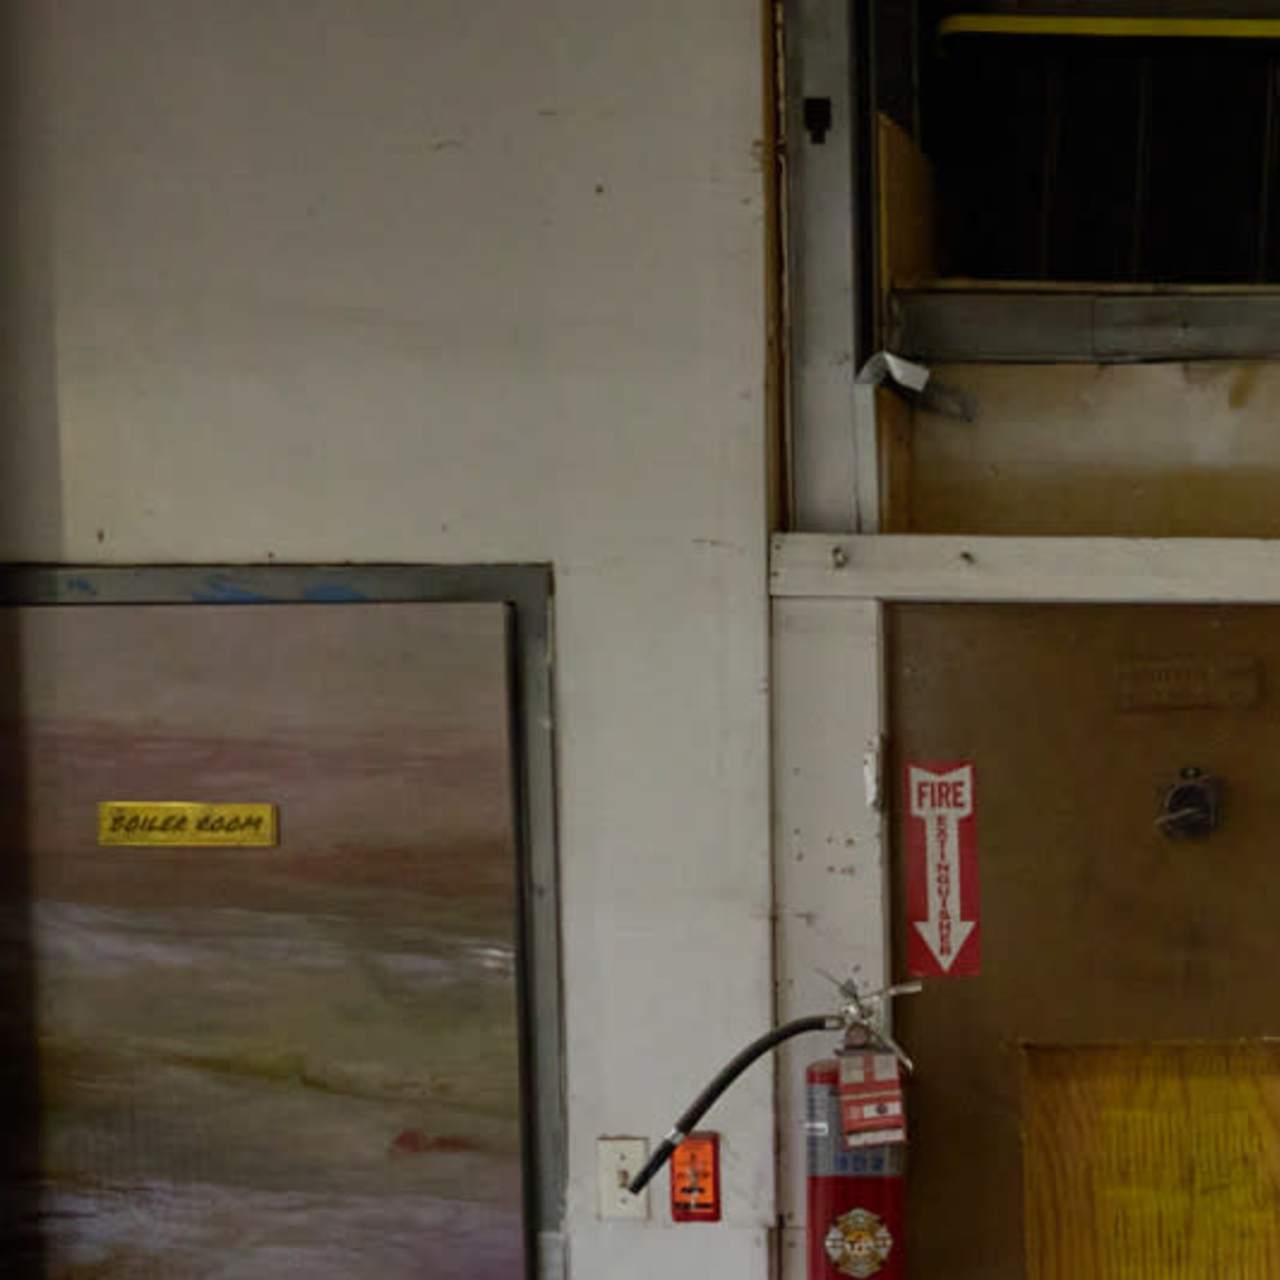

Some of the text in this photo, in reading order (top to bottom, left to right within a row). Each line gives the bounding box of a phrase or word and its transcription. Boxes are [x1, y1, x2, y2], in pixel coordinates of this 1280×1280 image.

[916, 780, 965, 808] FIRE
[109, 813, 263, 833] BOILER ROOM
